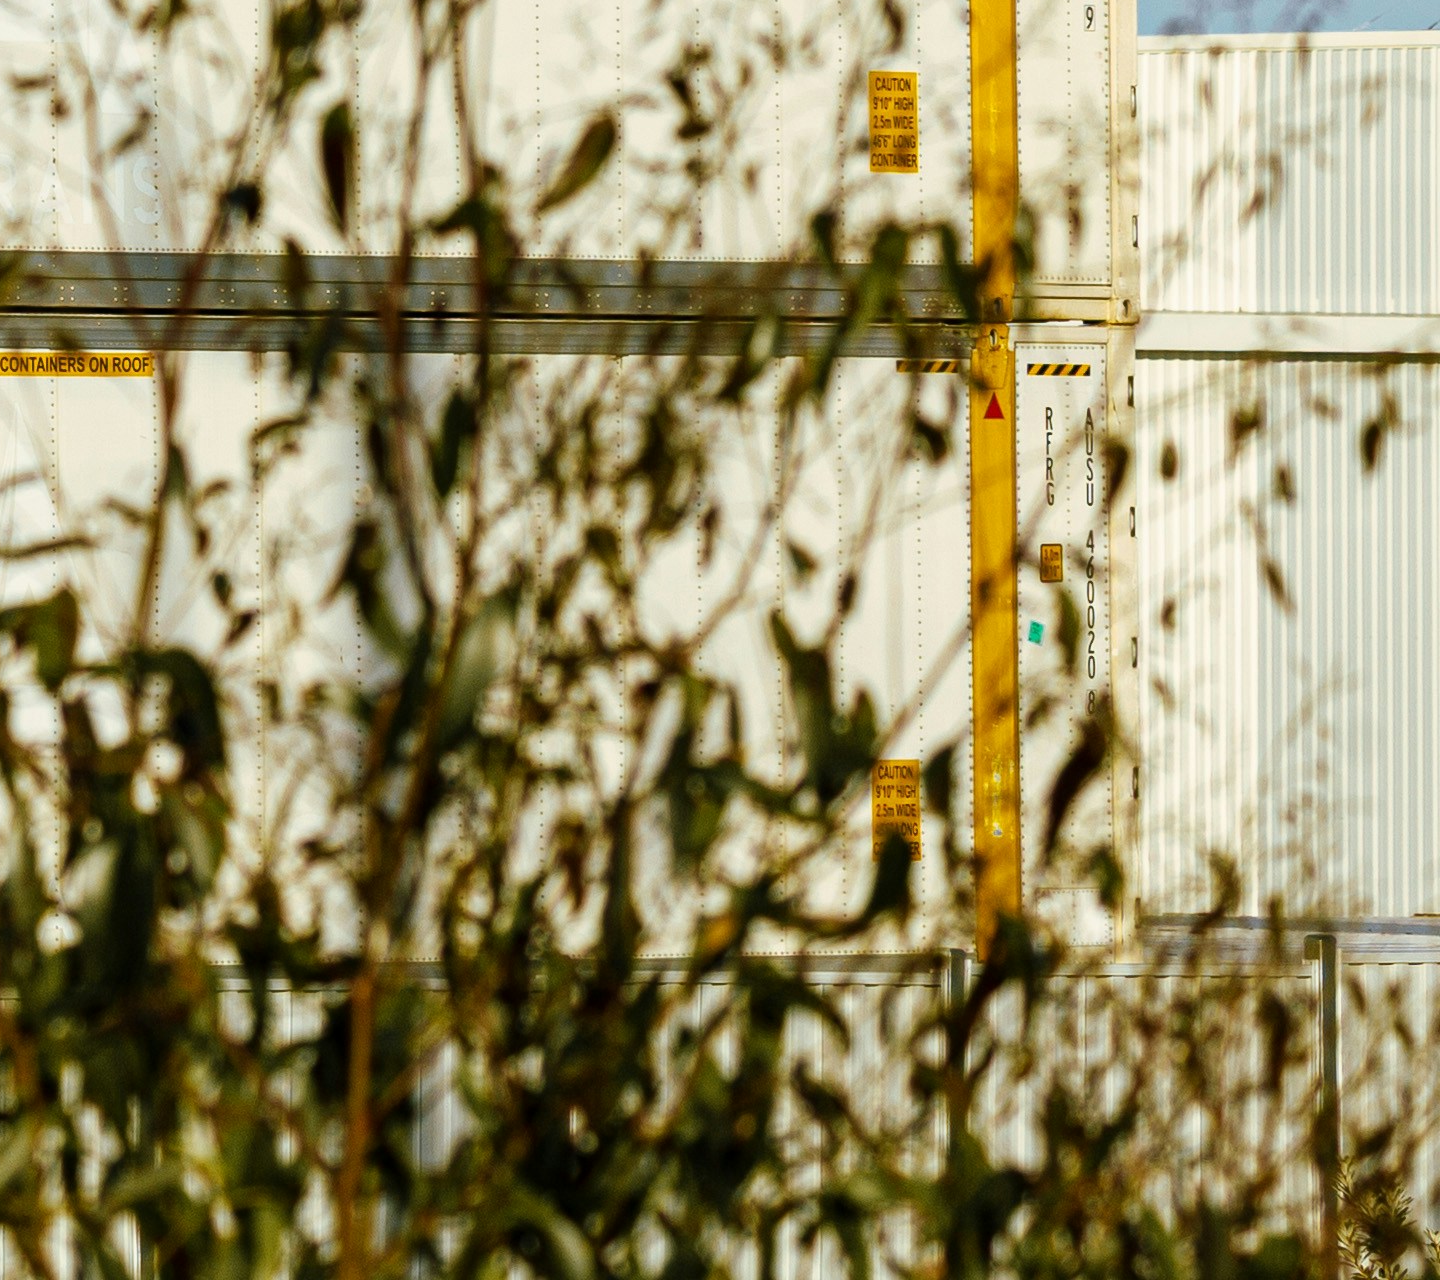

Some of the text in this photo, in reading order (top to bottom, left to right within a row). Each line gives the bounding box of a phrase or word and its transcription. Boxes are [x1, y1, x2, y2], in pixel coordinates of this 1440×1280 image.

[1085, 7, 1093, 29] 9
[875, 77, 911, 91] CAUTION
[894, 97, 914, 111] HIGH
[893, 116, 914, 130] WIDE
[893, 135, 916, 149] LONG
[871, 153, 918, 168] CONTAINER
[0, 356, 85, 373] CONTAINERS
[88, 356, 109, 373] ON
[112, 356, 150, 373] ROOF
[1045, 406, 1054, 506] RFRG
[1085, 407, 1095, 679] AUSU 460020
[878, 765, 913, 780] CAUTION
[896, 785, 916, 799] HIGH
[896, 803, 917, 817] WIDE
